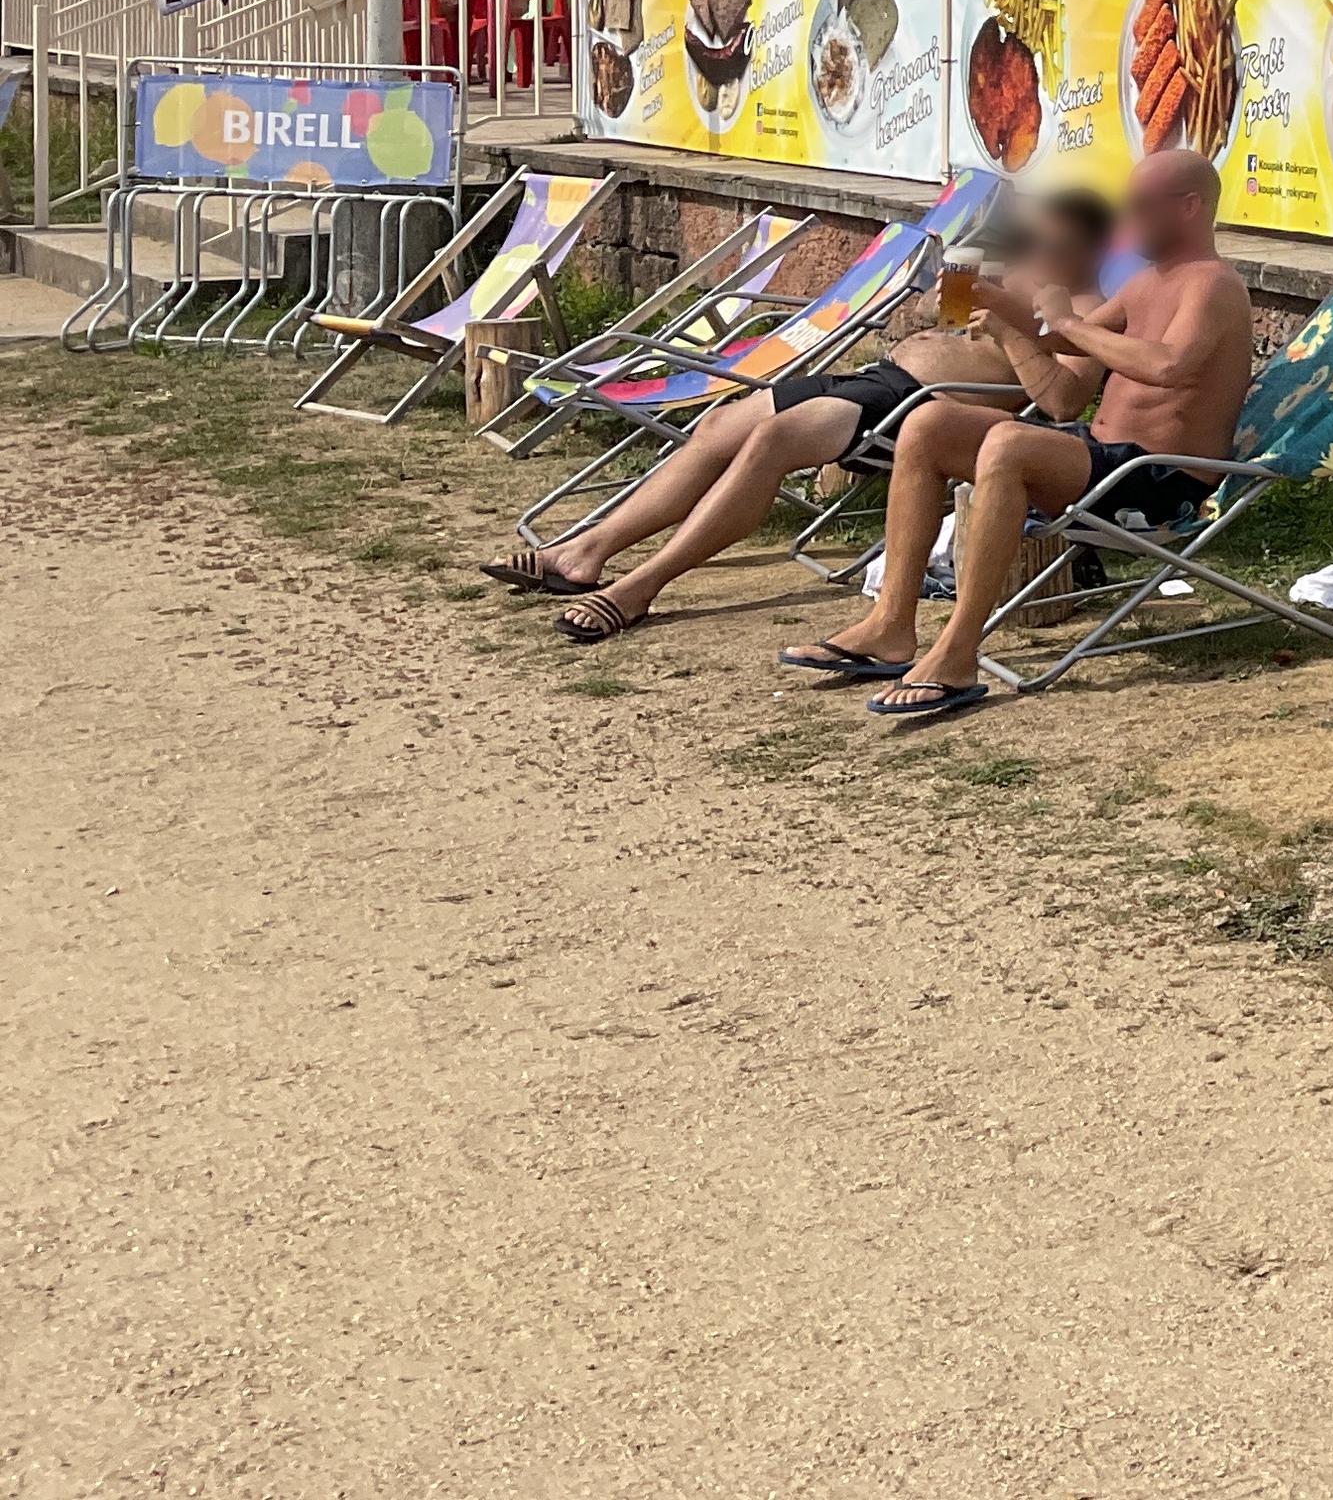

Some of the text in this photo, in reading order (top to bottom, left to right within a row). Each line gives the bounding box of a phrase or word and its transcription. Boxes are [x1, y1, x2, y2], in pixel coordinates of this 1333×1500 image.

[1241, 37, 1285, 89] Rybí
[223, 109, 362, 149] BIRELL
[1244, 88, 1290, 138] prsty
